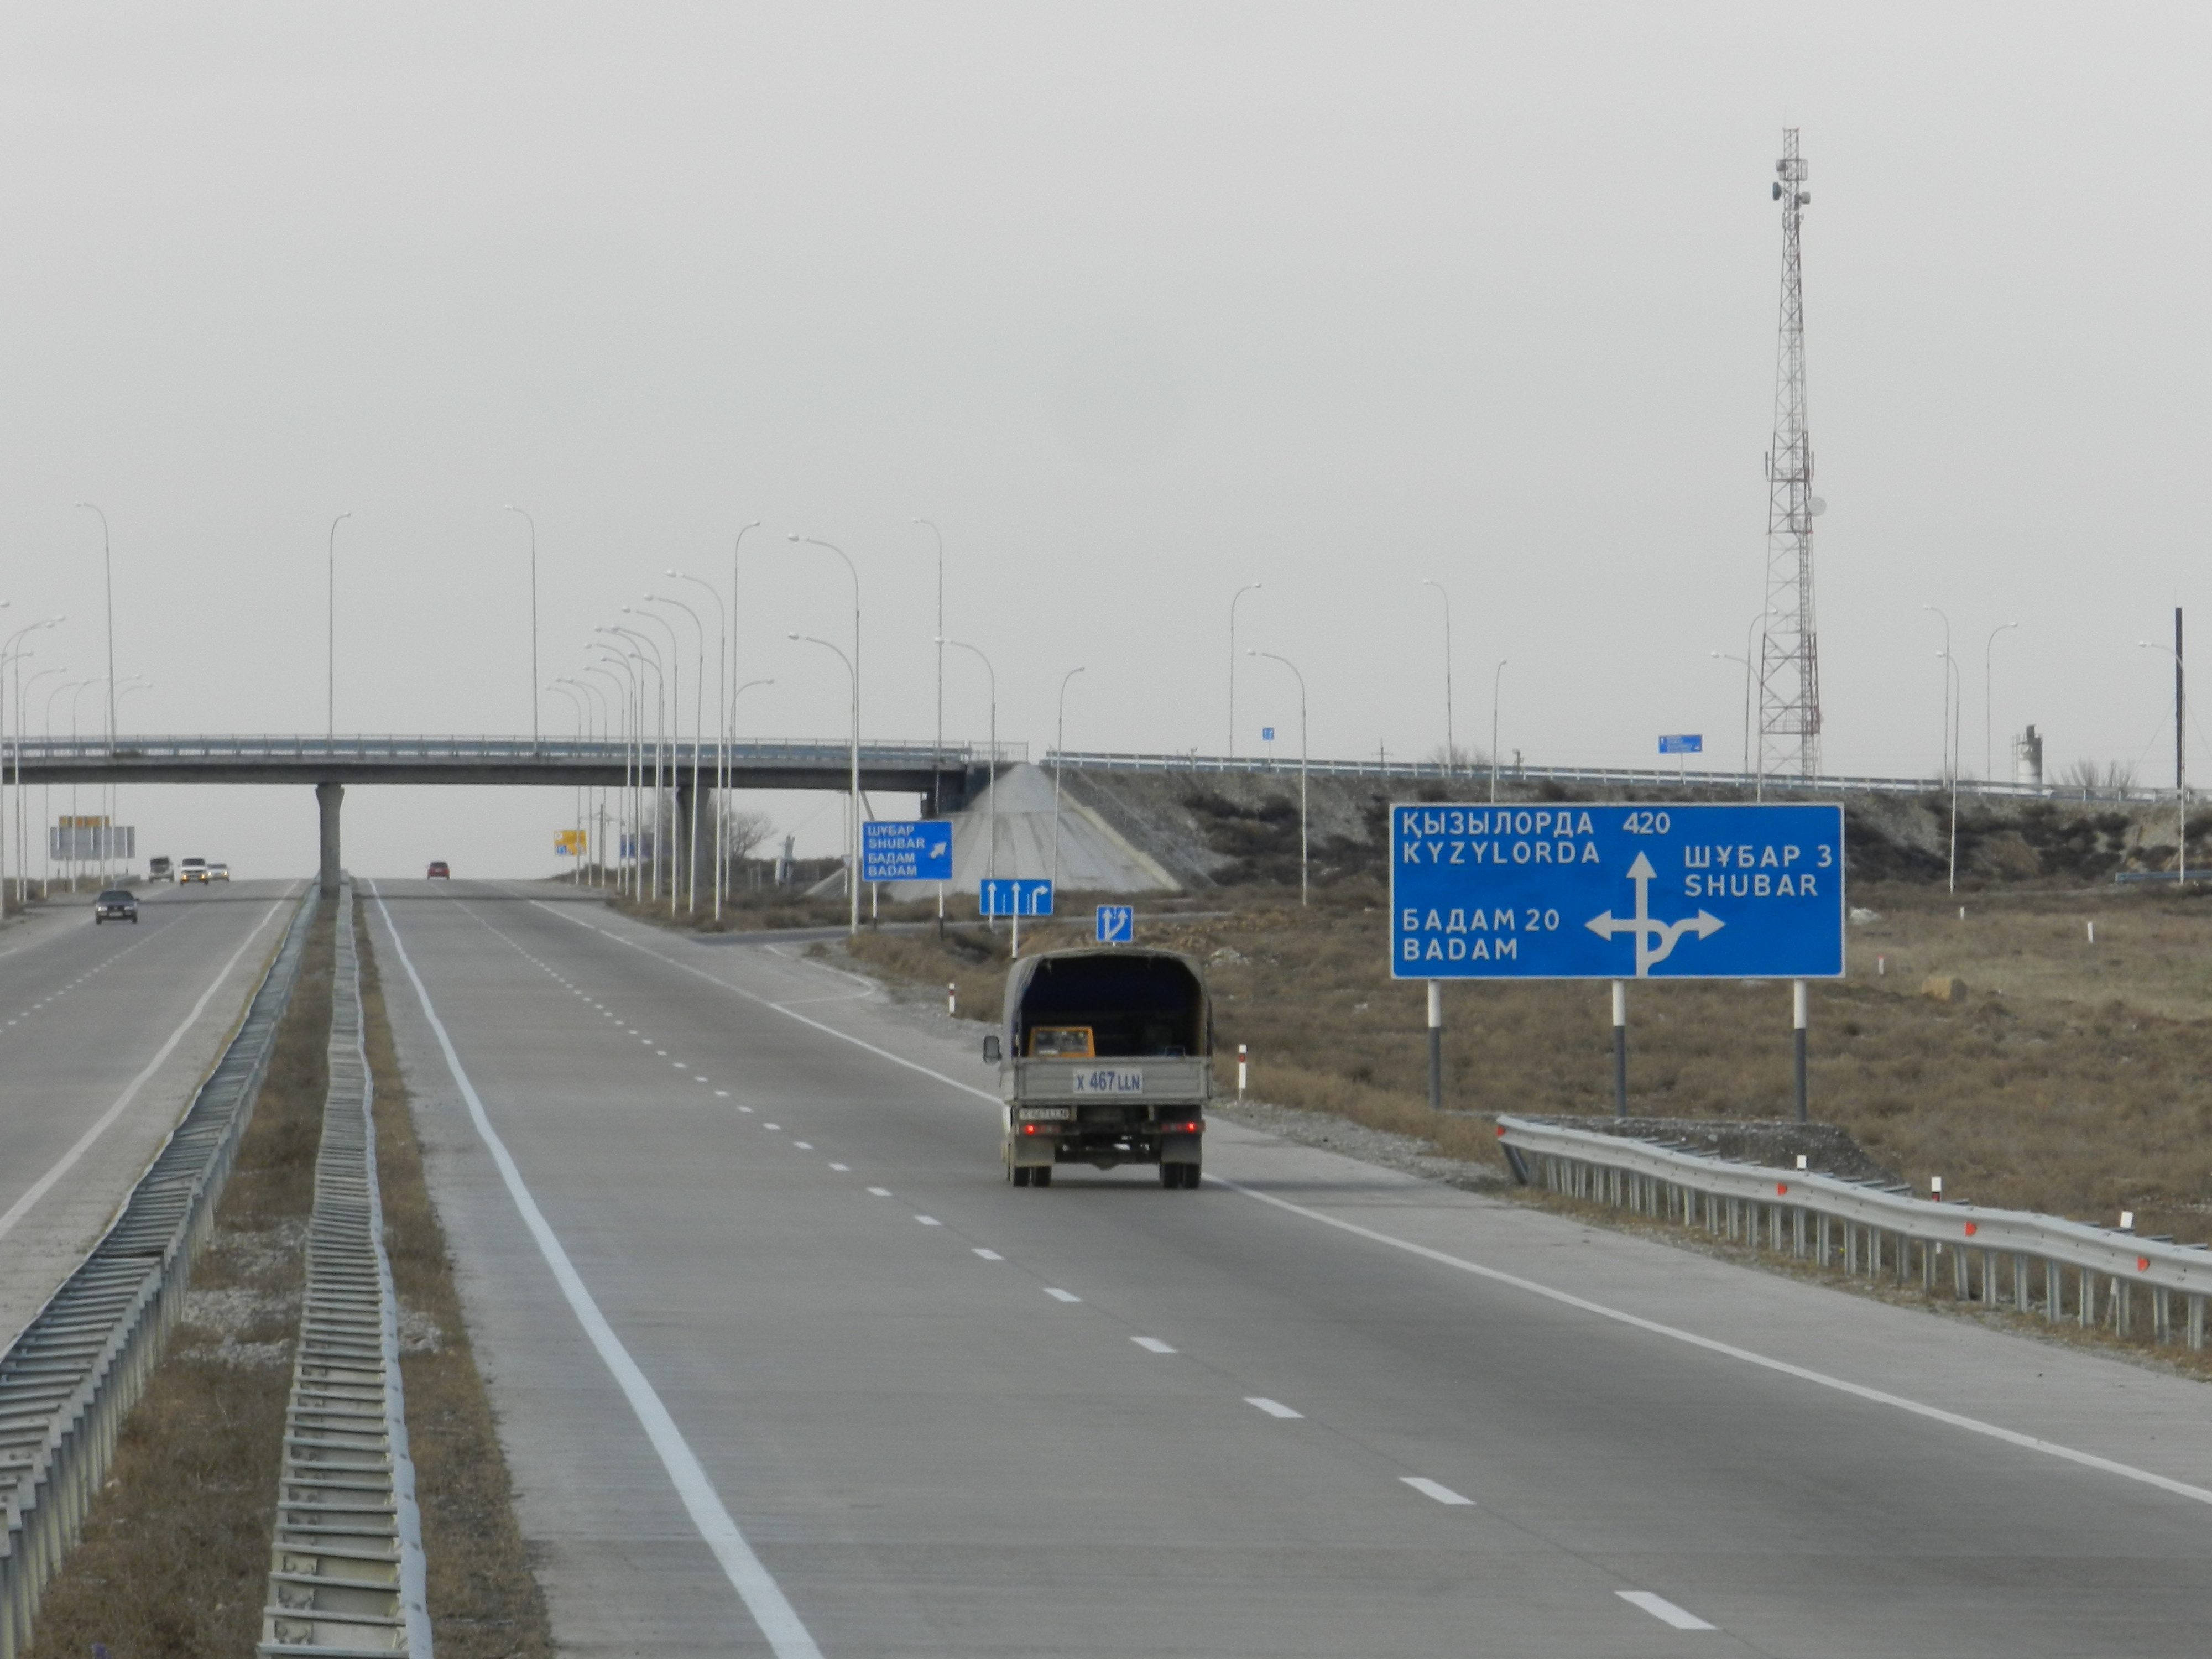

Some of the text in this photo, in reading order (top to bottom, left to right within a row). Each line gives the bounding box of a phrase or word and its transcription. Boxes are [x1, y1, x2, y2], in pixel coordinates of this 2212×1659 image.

[1404, 812, 1670, 838] ҚЫЗЫЛОРДА 420
[868, 838, 925, 849] SHUBAR
[1404, 841, 1600, 864] KYZYLORDA
[868, 852, 916, 864] БАДАМ
[1684, 844, 1832, 868] ШҰБАР 3
[868, 865, 917, 876] BADAM
[1684, 874, 1818, 897] SHUBAR
[1403, 909, 1559, 933] БАДАМ 20
[1403, 938, 1517, 961] BADAM
[1089, 1071, 1115, 1091] 467
[1118, 1074, 1140, 1091] LLN
